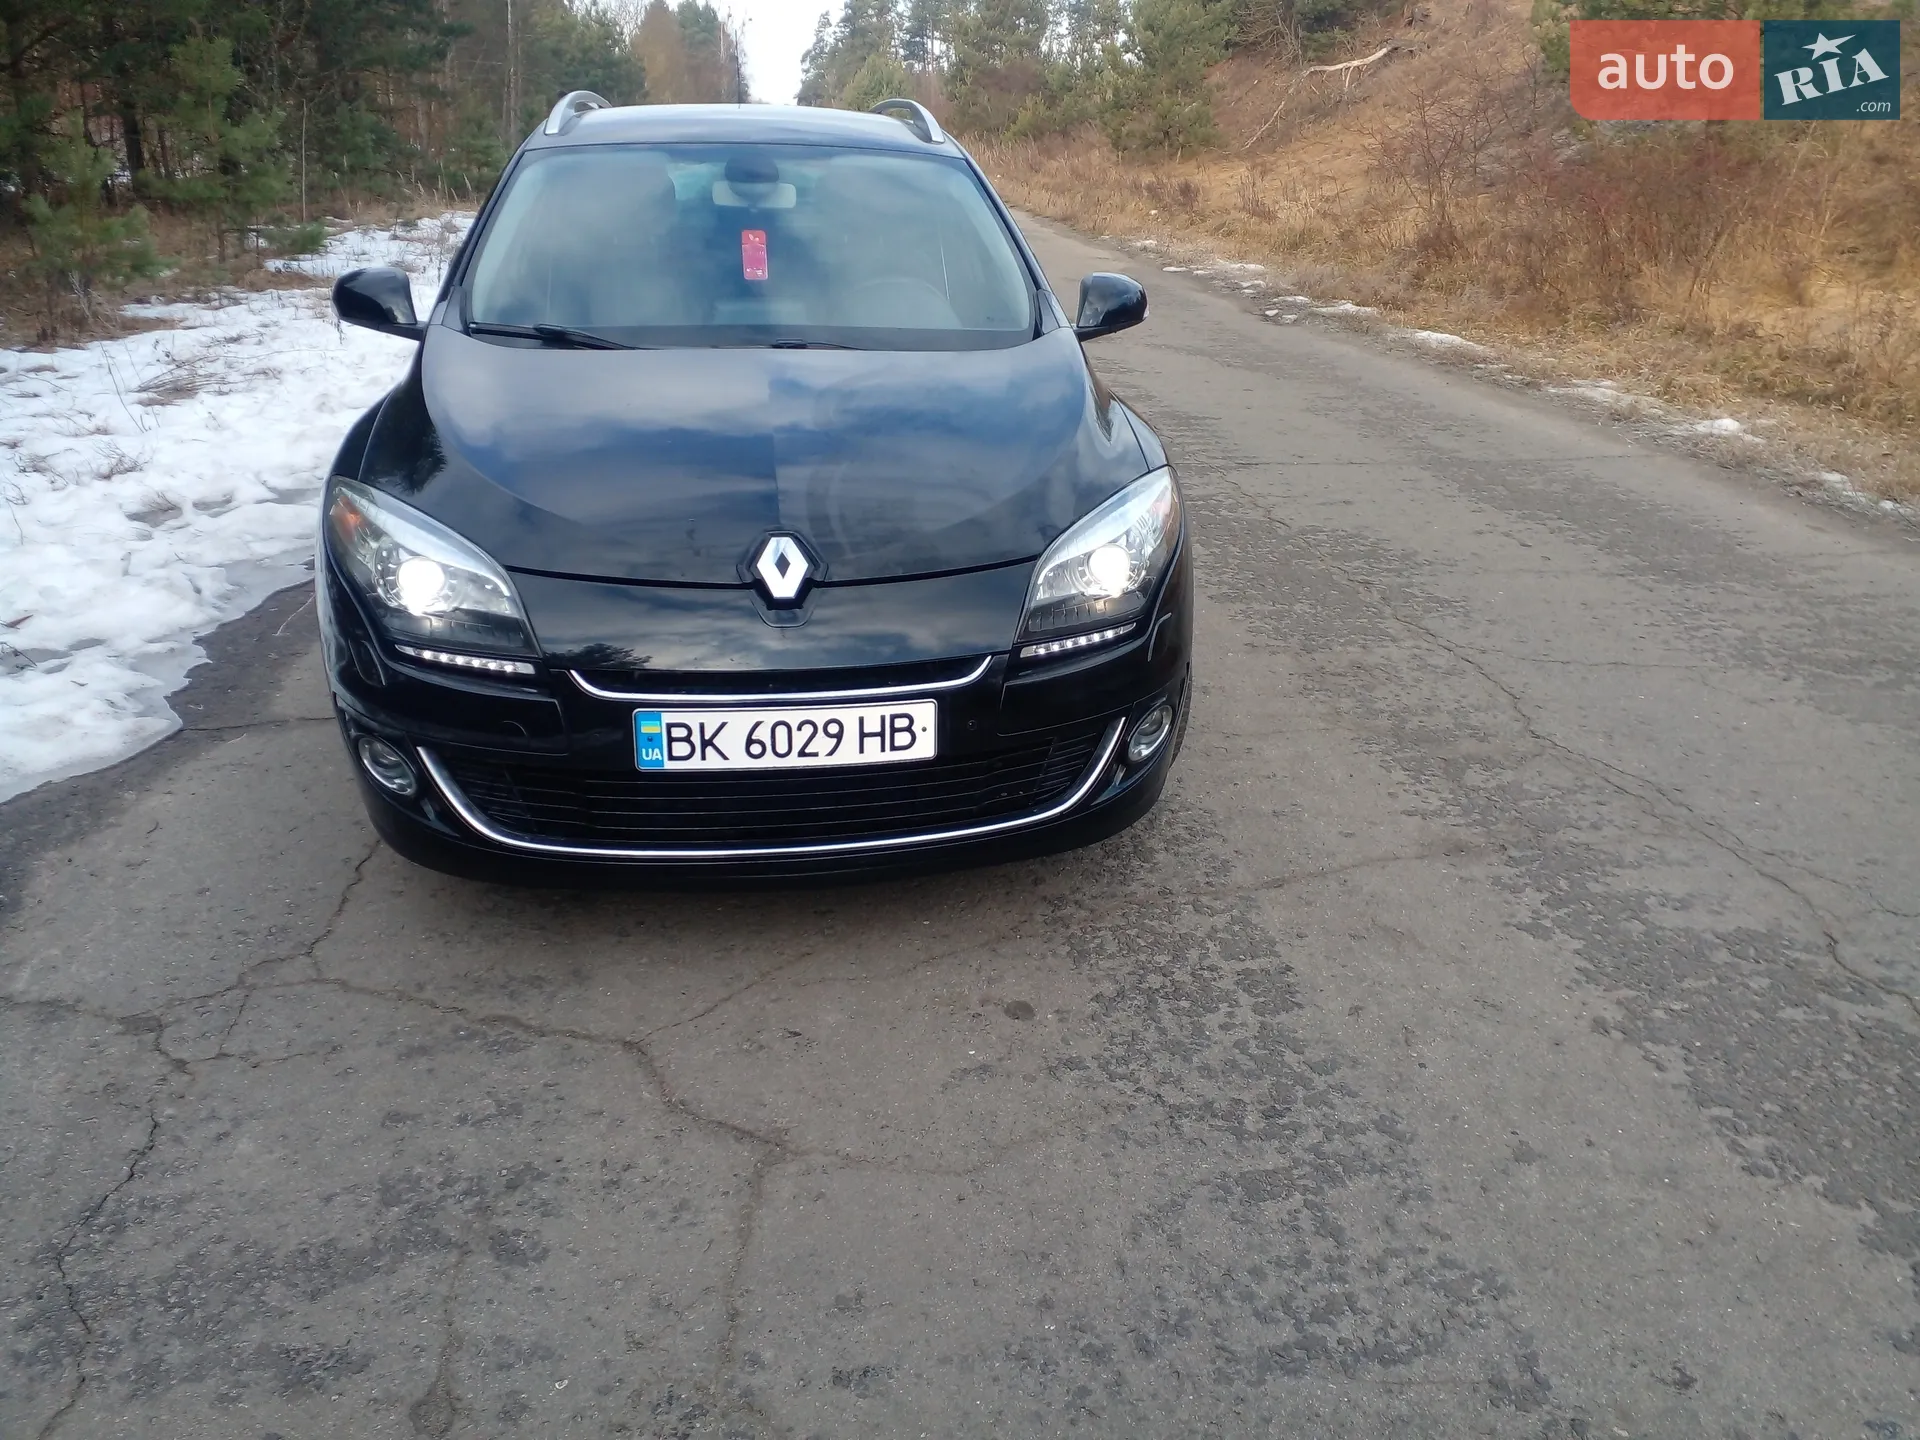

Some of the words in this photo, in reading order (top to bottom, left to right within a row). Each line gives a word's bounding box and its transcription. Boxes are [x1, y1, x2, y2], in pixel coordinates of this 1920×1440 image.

[666, 721, 729, 761] BK
[745, 718, 844, 759] 6029
[859, 713, 916, 754] HB
[642, 748, 662, 761] UA
